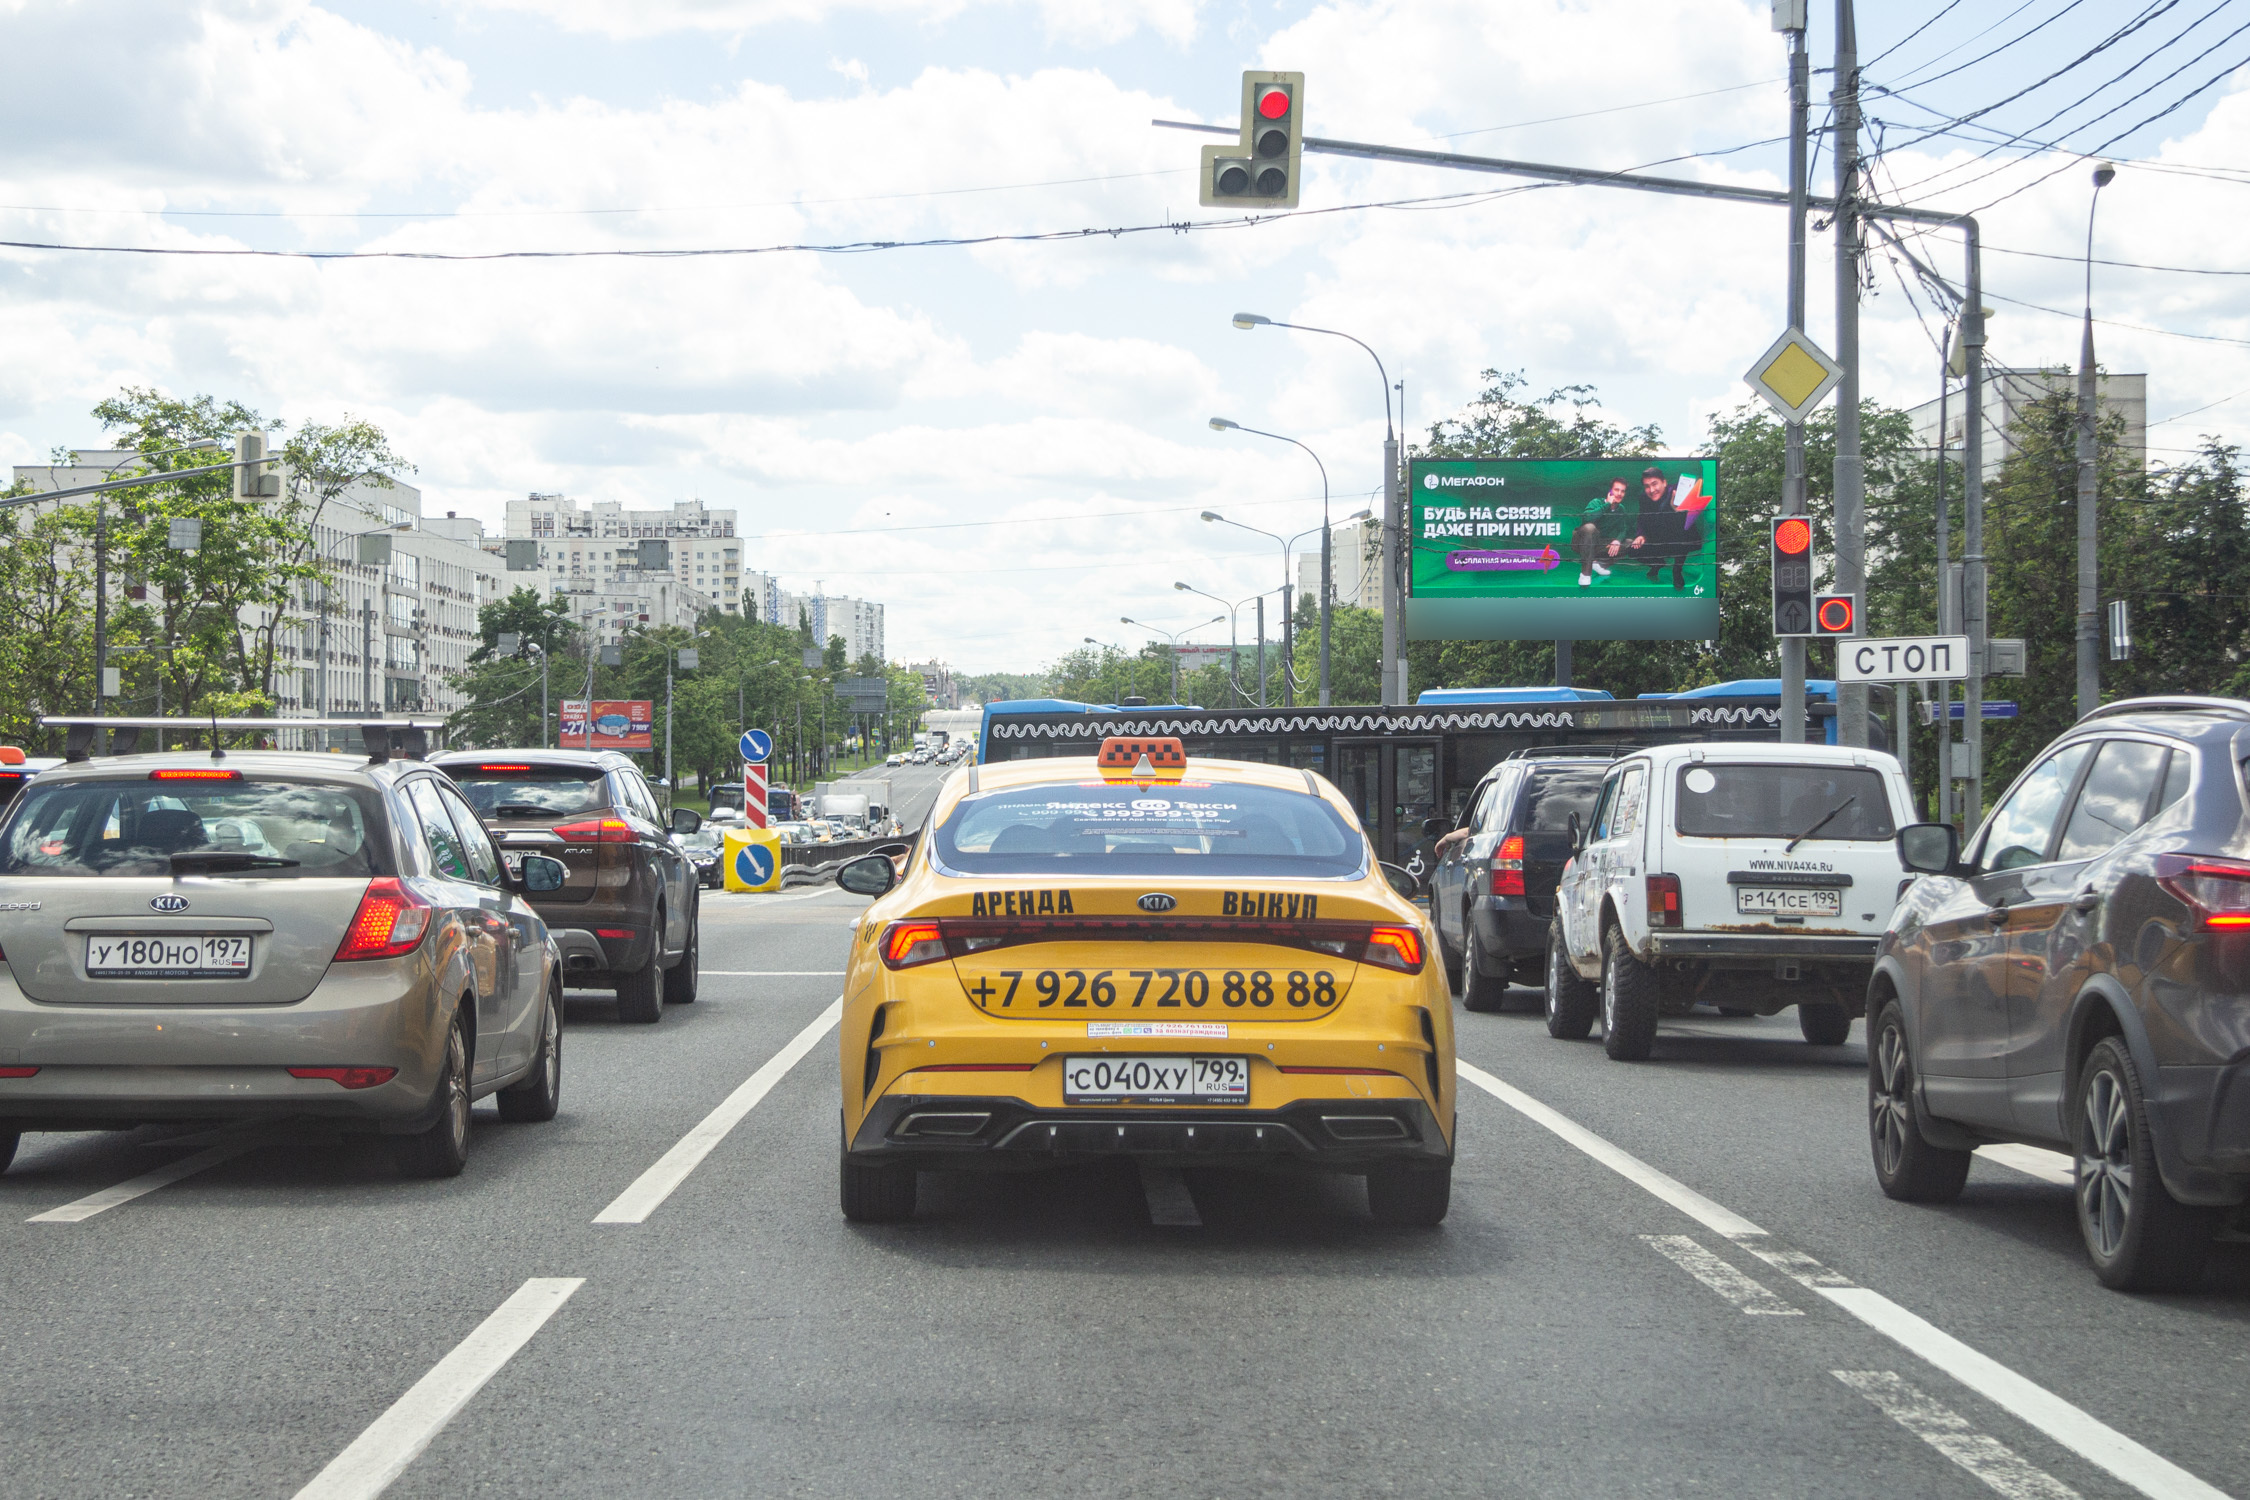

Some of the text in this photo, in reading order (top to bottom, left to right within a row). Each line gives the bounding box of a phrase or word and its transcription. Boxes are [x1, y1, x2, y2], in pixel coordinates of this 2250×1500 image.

[1424, 506, 1551, 522] БУДЬ НА СВЯЗИ
[1424, 523, 1561, 538] ДАЖЕ ПРИ НУЛЕ!
[1694, 585, 1705, 595] 6+
[1855, 644, 1950, 674] СТОП
[1583, 713, 1601, 726] 49
[1046, 802, 1126, 810] Яндекс
[1174, 801, 1237, 810] Такси
[1102, 810, 1219, 818] 999-99-99
[156, 897, 183, 909] KIA
[972, 889, 1075, 917] АРЕНДА
[1142, 896, 1172, 910] KIA
[1222, 890, 1318, 919] ВЫКУП
[1811, 891, 1835, 904] 199
[205, 939, 243, 958] 197
[211, 958, 231, 966] RUS
[971, 970, 1337, 1008] +7 926 720 88 88
[1195, 1060, 1239, 1082] 799
[1206, 1083, 1228, 1091] RUS
